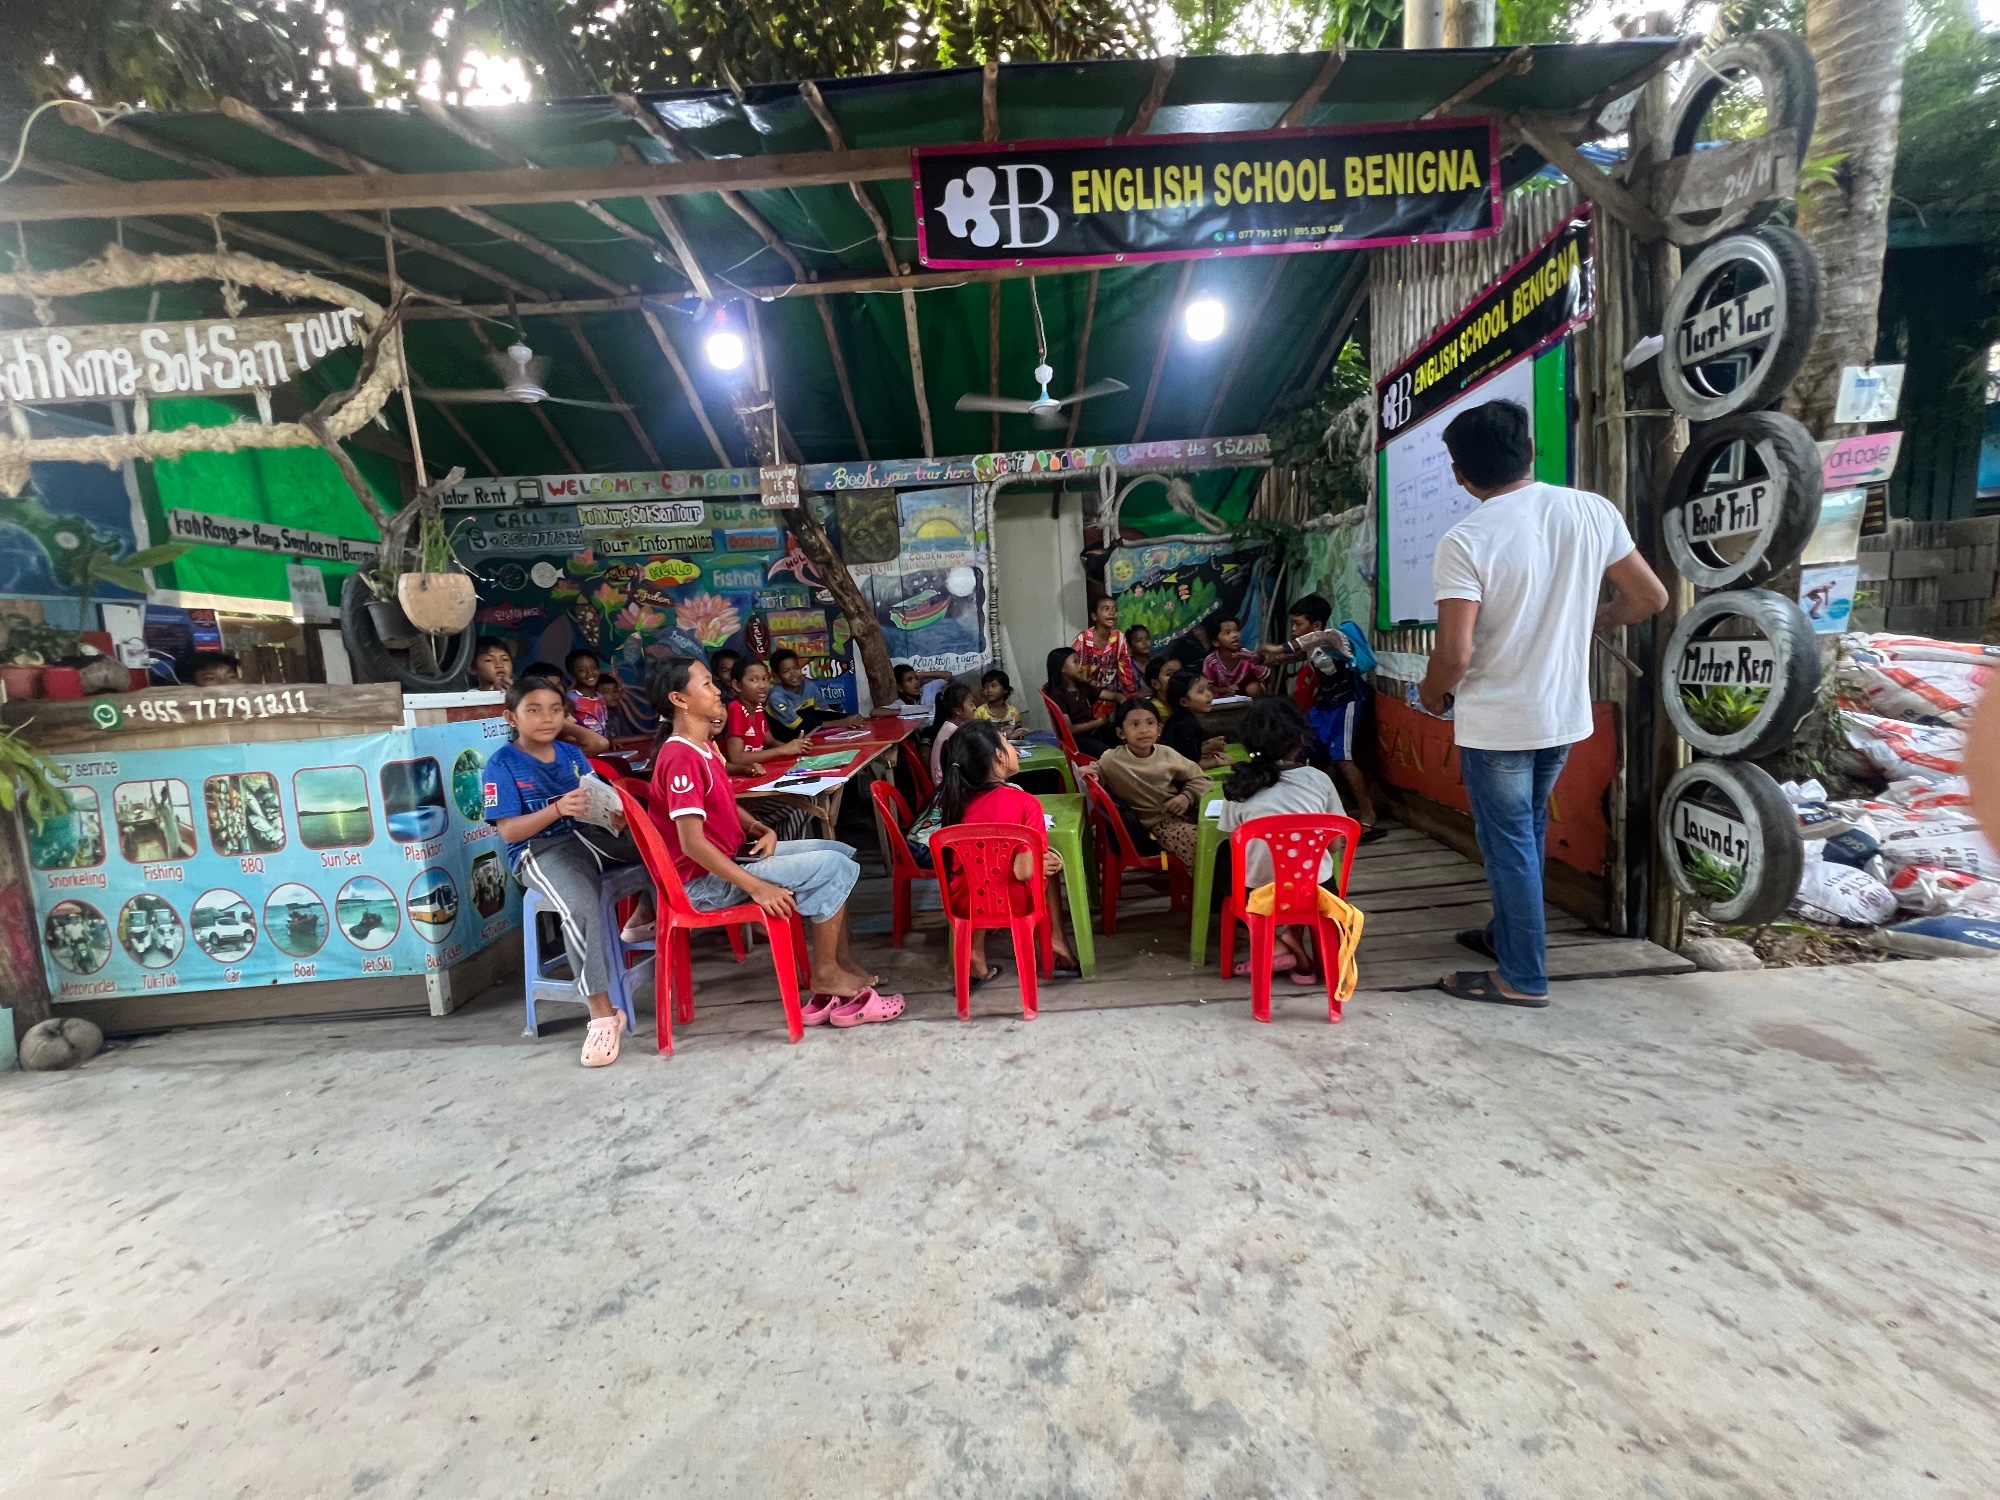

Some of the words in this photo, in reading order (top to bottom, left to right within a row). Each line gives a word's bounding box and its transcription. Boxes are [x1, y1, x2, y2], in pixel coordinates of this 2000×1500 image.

[1072, 165, 1204, 214] ENGLISH
[1214, 158, 1336, 206] SCHOOL
[1344, 150, 1481, 196] BENIGNA
[1413, 340, 1459, 396] ENGLISH
[1460, 310, 1509, 363] SCHOOL
[1511, 239, 1582, 324] BENIGNA
[47, 335, 143, 398] Rong
[773, 481, 784, 491] is
[825, 464, 879, 490] Book
[882, 470, 910, 488] your
[943, 465, 971, 481] here
[474, 486, 507, 505] Rent
[546, 477, 640, 497] WELCOME
[494, 511, 544, 528] CALL
[602, 505, 631, 529] Rong
[596, 537, 630, 554] Tour
[908, 552, 943, 562] GOLDEN
[650, 561, 693, 578] HELLO
[1682, 647, 1735, 684] Motor
[122, 699, 180, 724] +855
[74, 758, 119, 780] service
[462, 826, 499, 844] Snorkeling
[320, 852, 340, 869] Sun
[342, 850, 362, 867] Set
[404, 841, 444, 862] Plankton
[143, 864, 185, 884] Fishing
[240, 857, 266, 875] BBQ
[47, 872, 107, 890] Snorkeling
[361, 956, 378, 973] Jet
[378, 955, 394, 973] Ski
[426, 950, 442, 969] Bus
[223, 967, 242, 984] Car
[293, 961, 317, 979] Boat
[60, 979, 117, 996] Motorcycles
[142, 971, 179, 989] Tuk-Tuk
